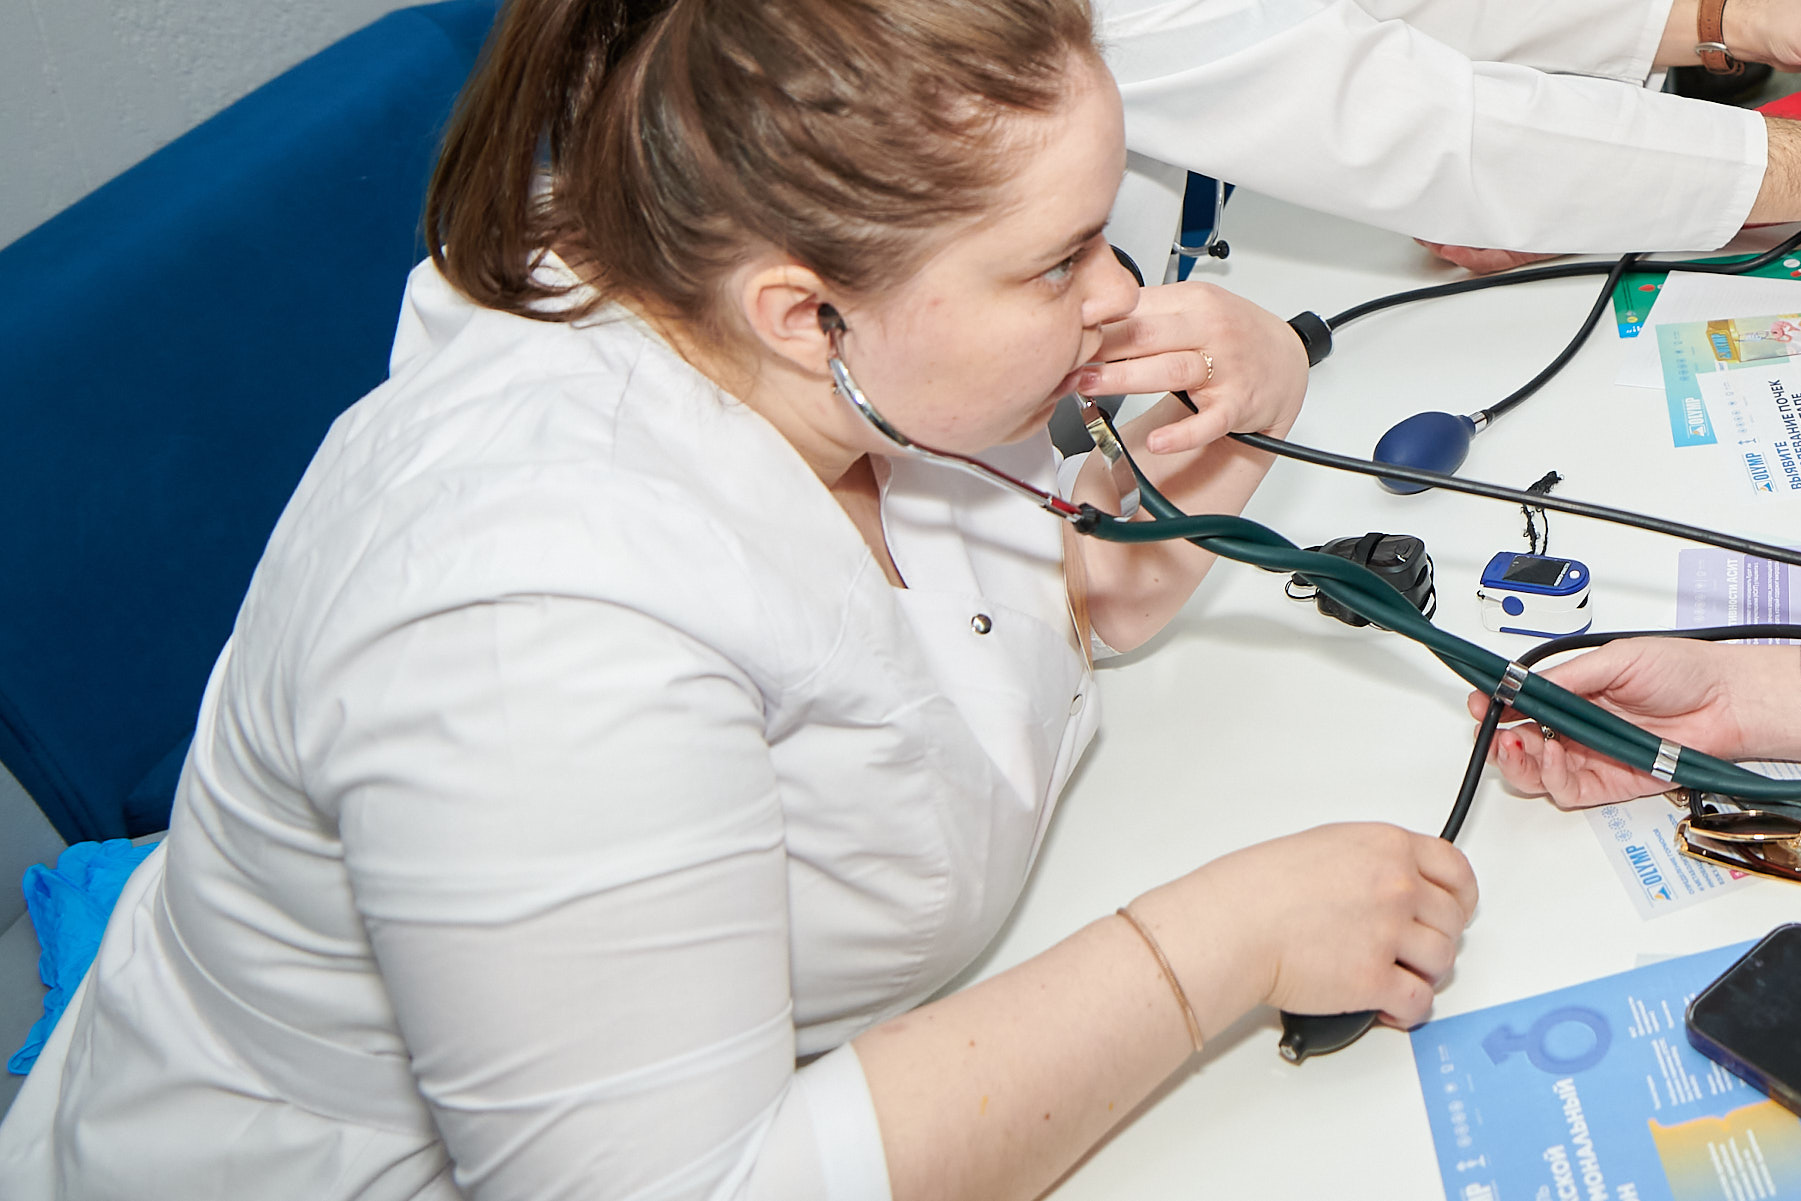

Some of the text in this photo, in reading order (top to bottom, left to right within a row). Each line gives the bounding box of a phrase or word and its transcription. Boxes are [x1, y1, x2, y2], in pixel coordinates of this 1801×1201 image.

[1684, 396, 1705, 425] OLYMP
[1767, 378, 1792, 412] ПОЧЕК
[1743, 450, 1770, 481] OLYMP
[1726, 557, 1738, 583] АСИТ
[1625, 844, 1663, 886] OLYMP
[1552, 1077, 1610, 1201] МОНАЛЬНЫЙ
[1543, 1144, 1581, 1201] СКОЙ
